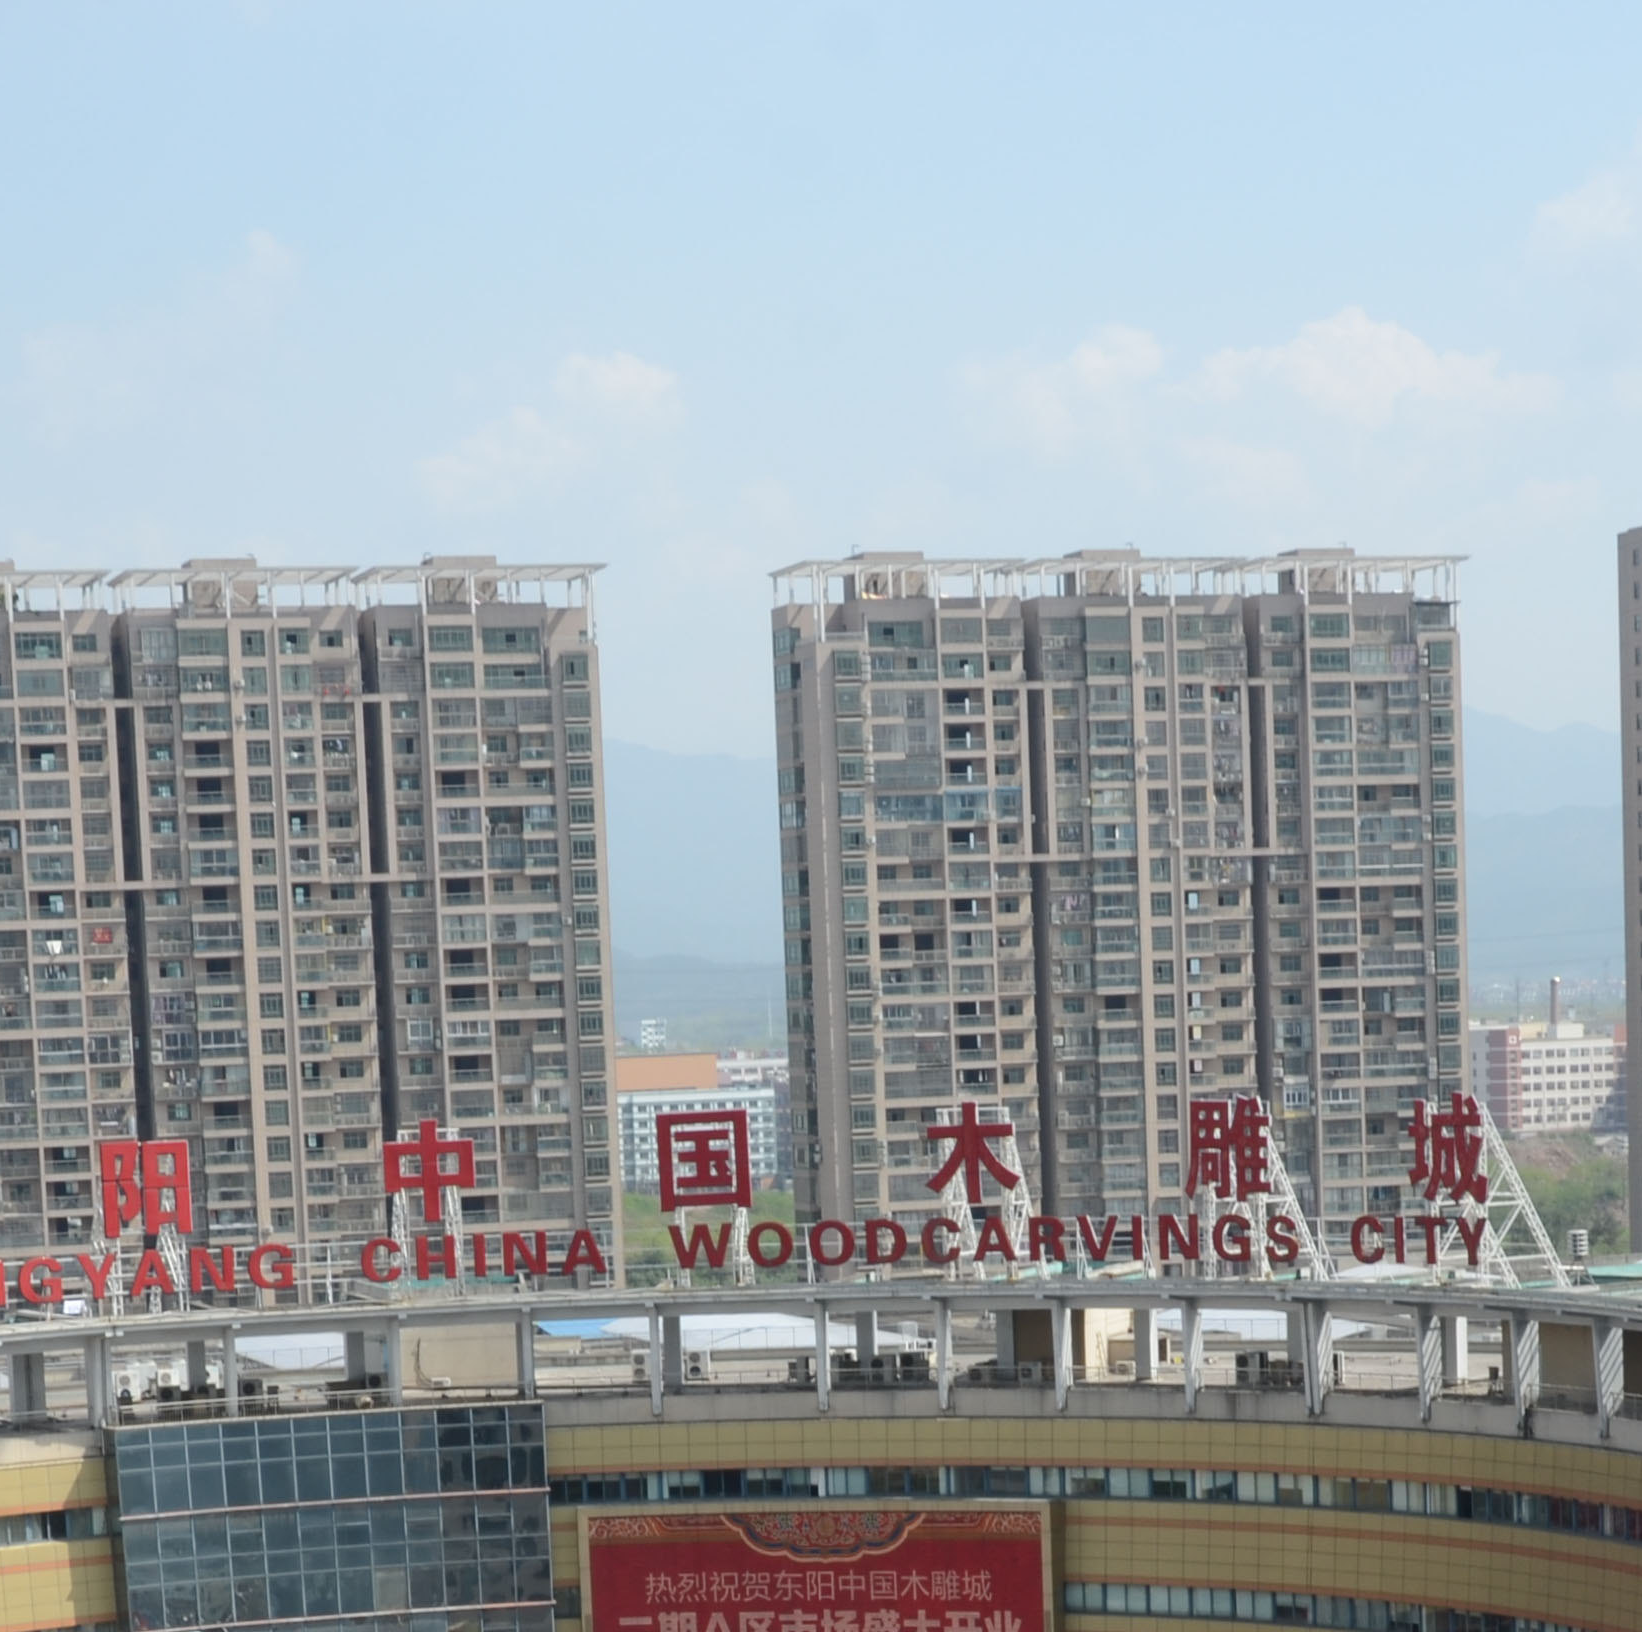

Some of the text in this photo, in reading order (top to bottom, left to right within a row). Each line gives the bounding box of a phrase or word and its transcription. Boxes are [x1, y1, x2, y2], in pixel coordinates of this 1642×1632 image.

[360, 1229, 609, 1284] CHINA
[667, 1213, 1302, 1270] WOODCARVINGS
[1356, 1213, 1489, 1268] CITY
[644, 1569, 994, 1603] 热烈祝贺东阳中国木雕城
